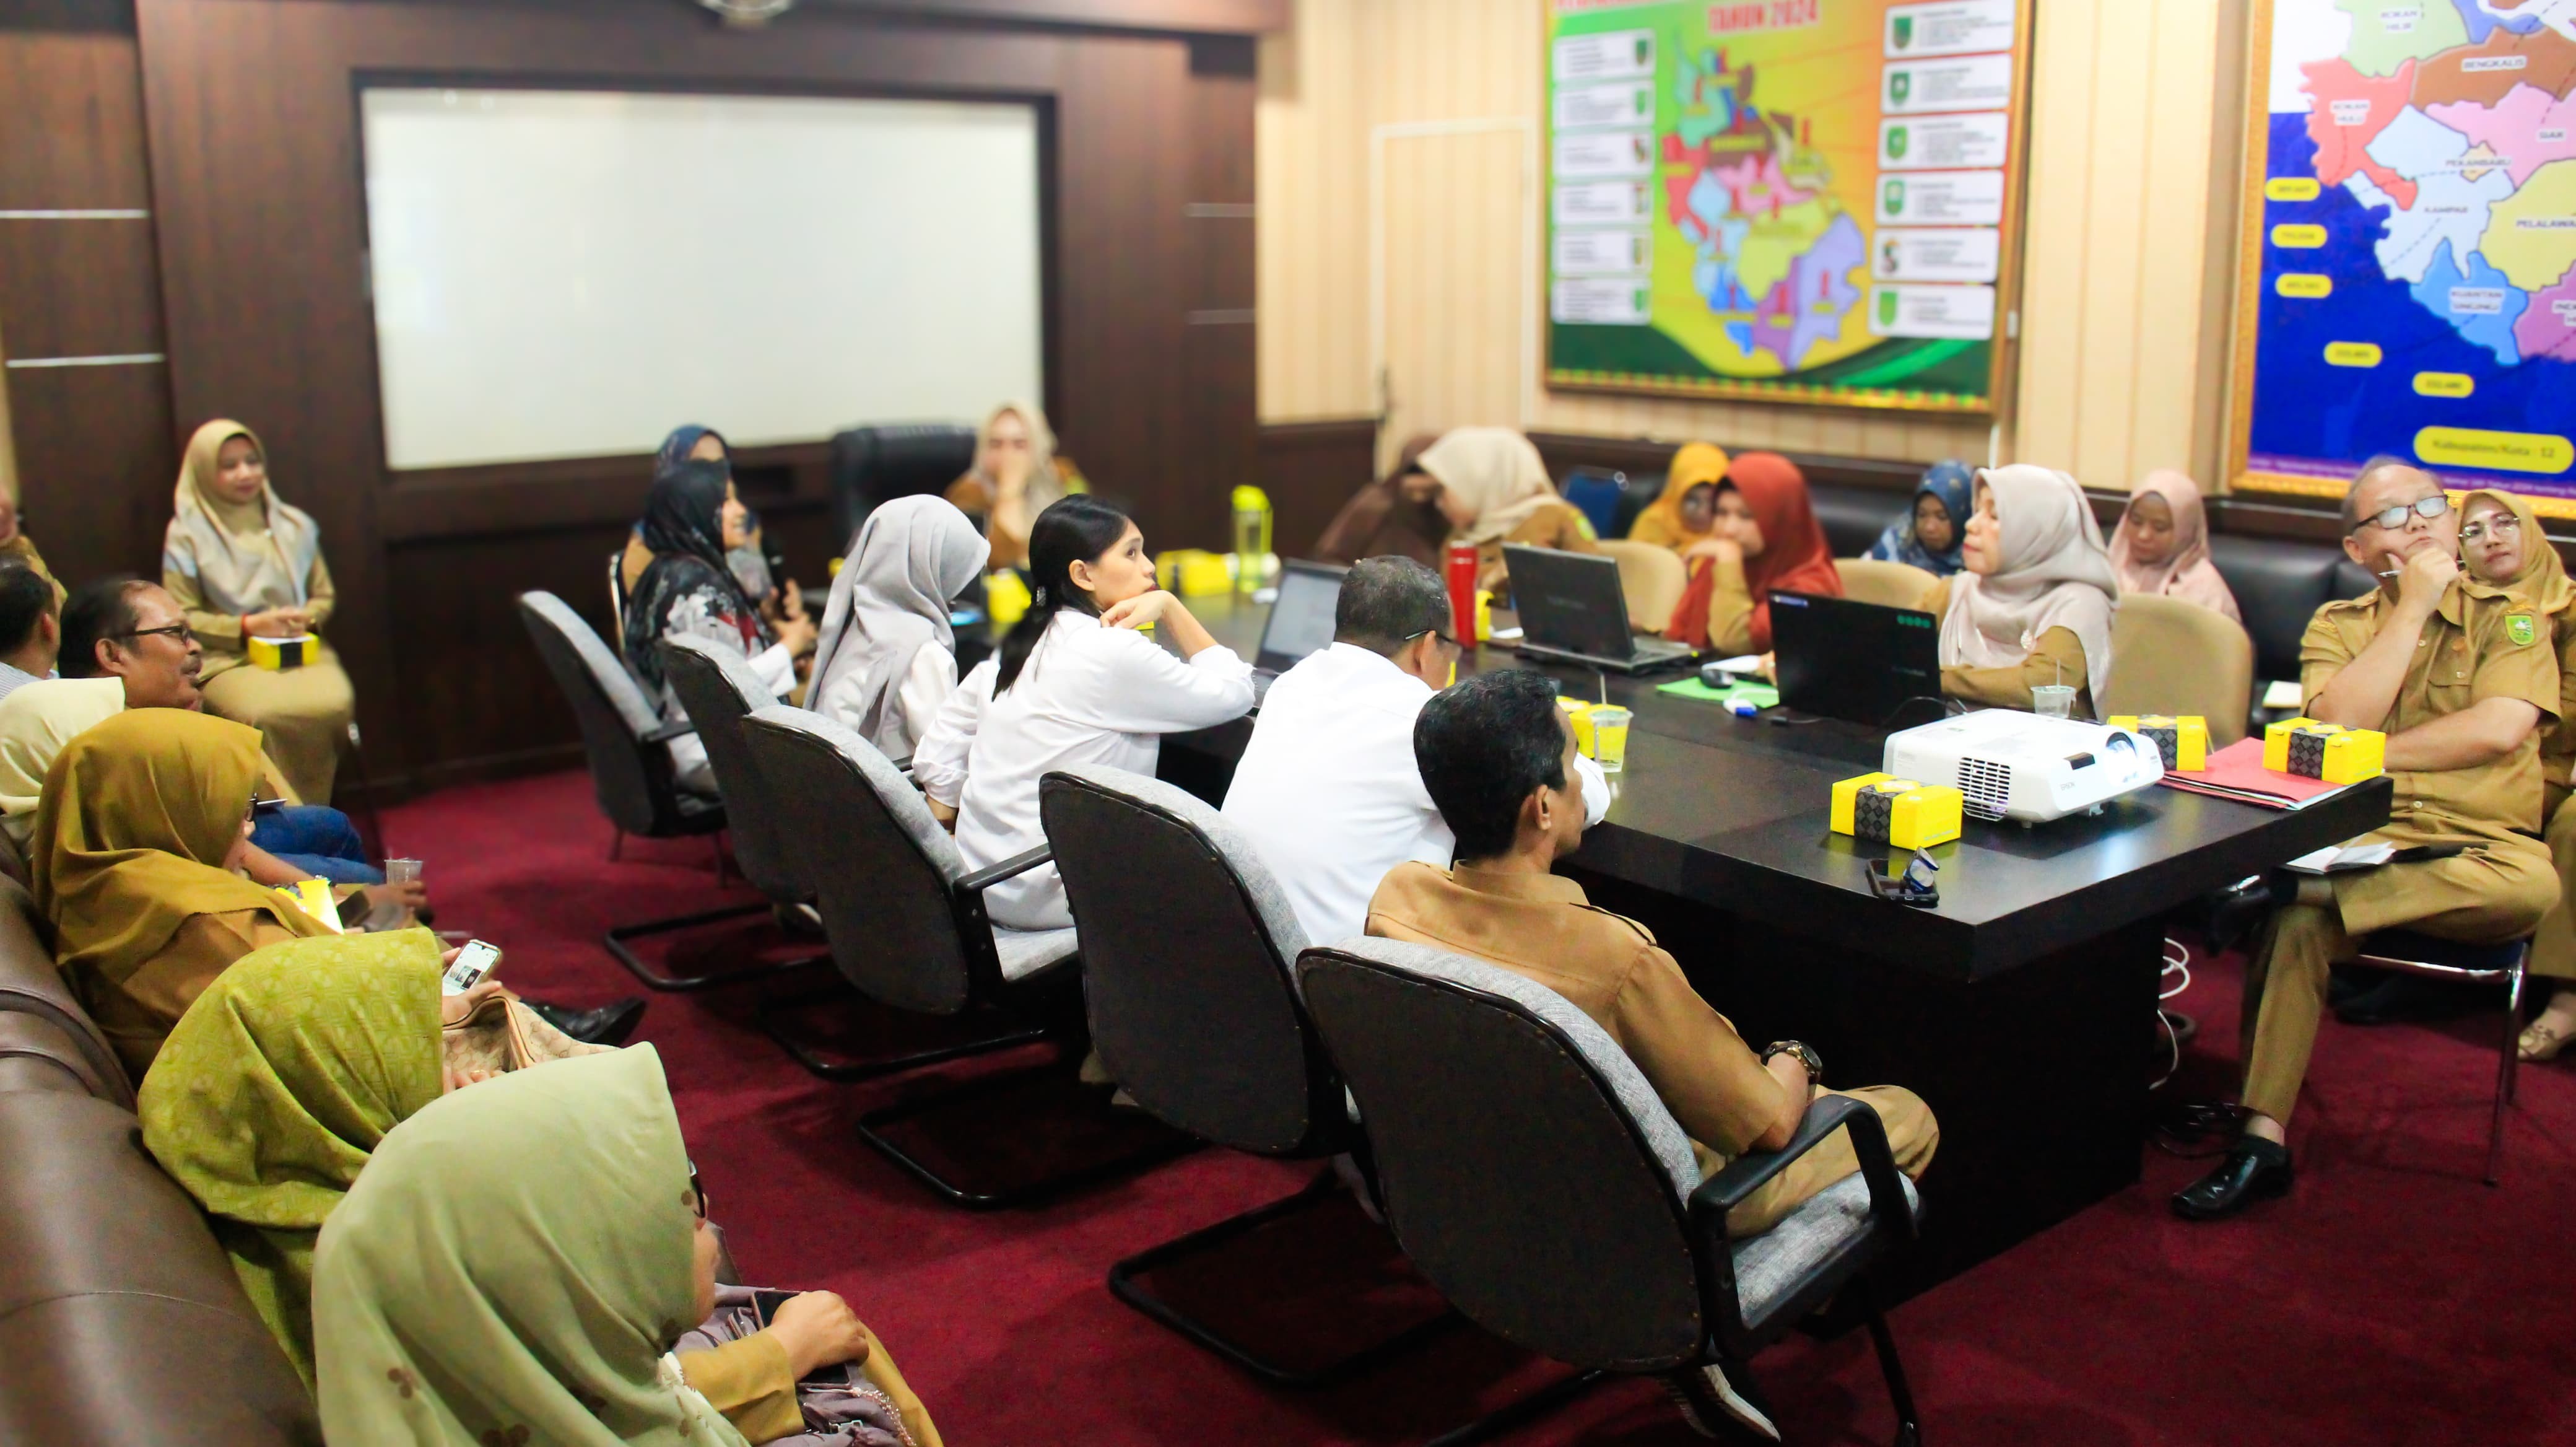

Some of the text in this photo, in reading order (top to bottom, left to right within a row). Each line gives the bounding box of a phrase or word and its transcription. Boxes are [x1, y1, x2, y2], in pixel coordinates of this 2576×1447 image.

[1709, 4, 1764, 31] TAHUN
[2463, 58, 2526, 69] BENGKALIS
[2539, 131, 2565, 139] SIAK
[2445, 158, 2511, 167] PEKANBARU
[2424, 206, 2468, 214] KAMPAR
[2432, 439, 2530, 457] Kabupaten/Kota
[2541, 447, 2555, 458] 12
[2060, 781, 2076, 792] EPSON
